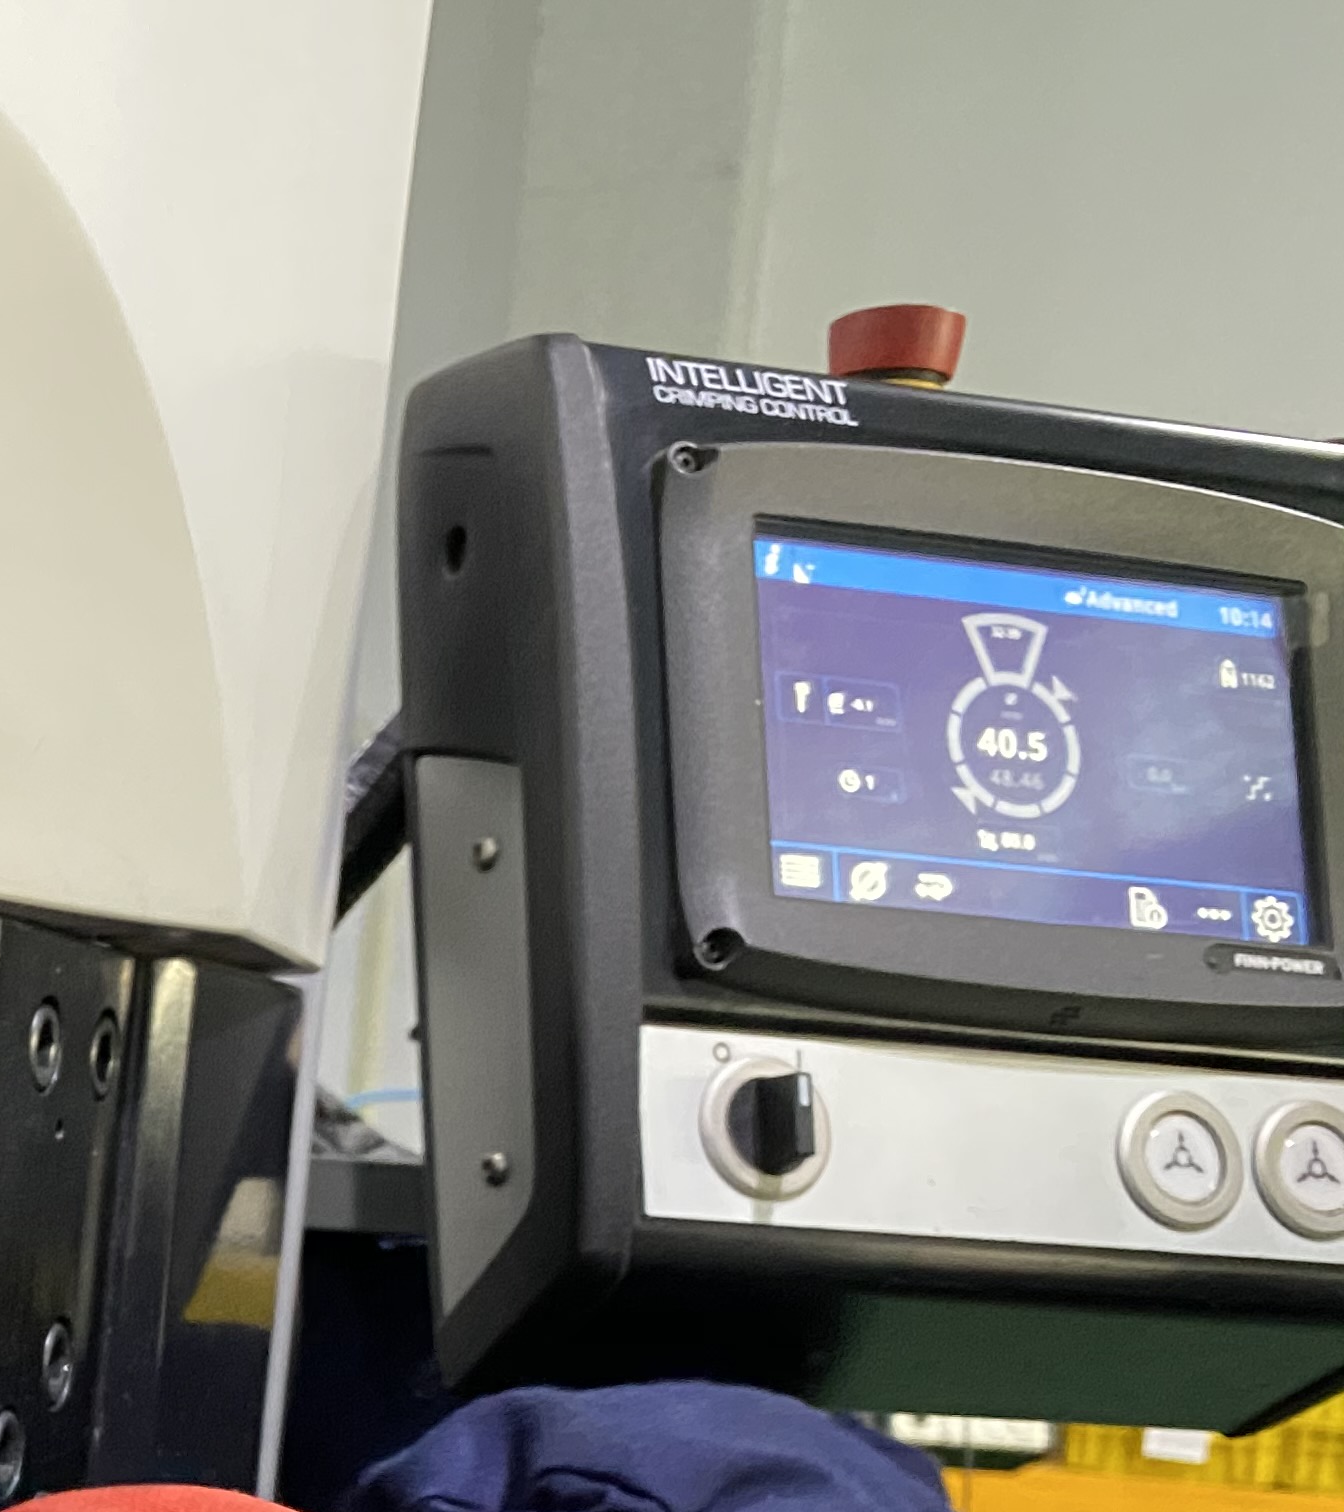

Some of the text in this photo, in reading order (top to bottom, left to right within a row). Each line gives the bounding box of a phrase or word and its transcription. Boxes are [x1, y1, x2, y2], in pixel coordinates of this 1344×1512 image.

[645, 356, 848, 405] INTELLIGENT
[653, 385, 859, 427] CRIMPING CONTROL
[1086, 590, 1273, 629] Advanced 10:14
[976, 727, 1048, 762] 40.5
